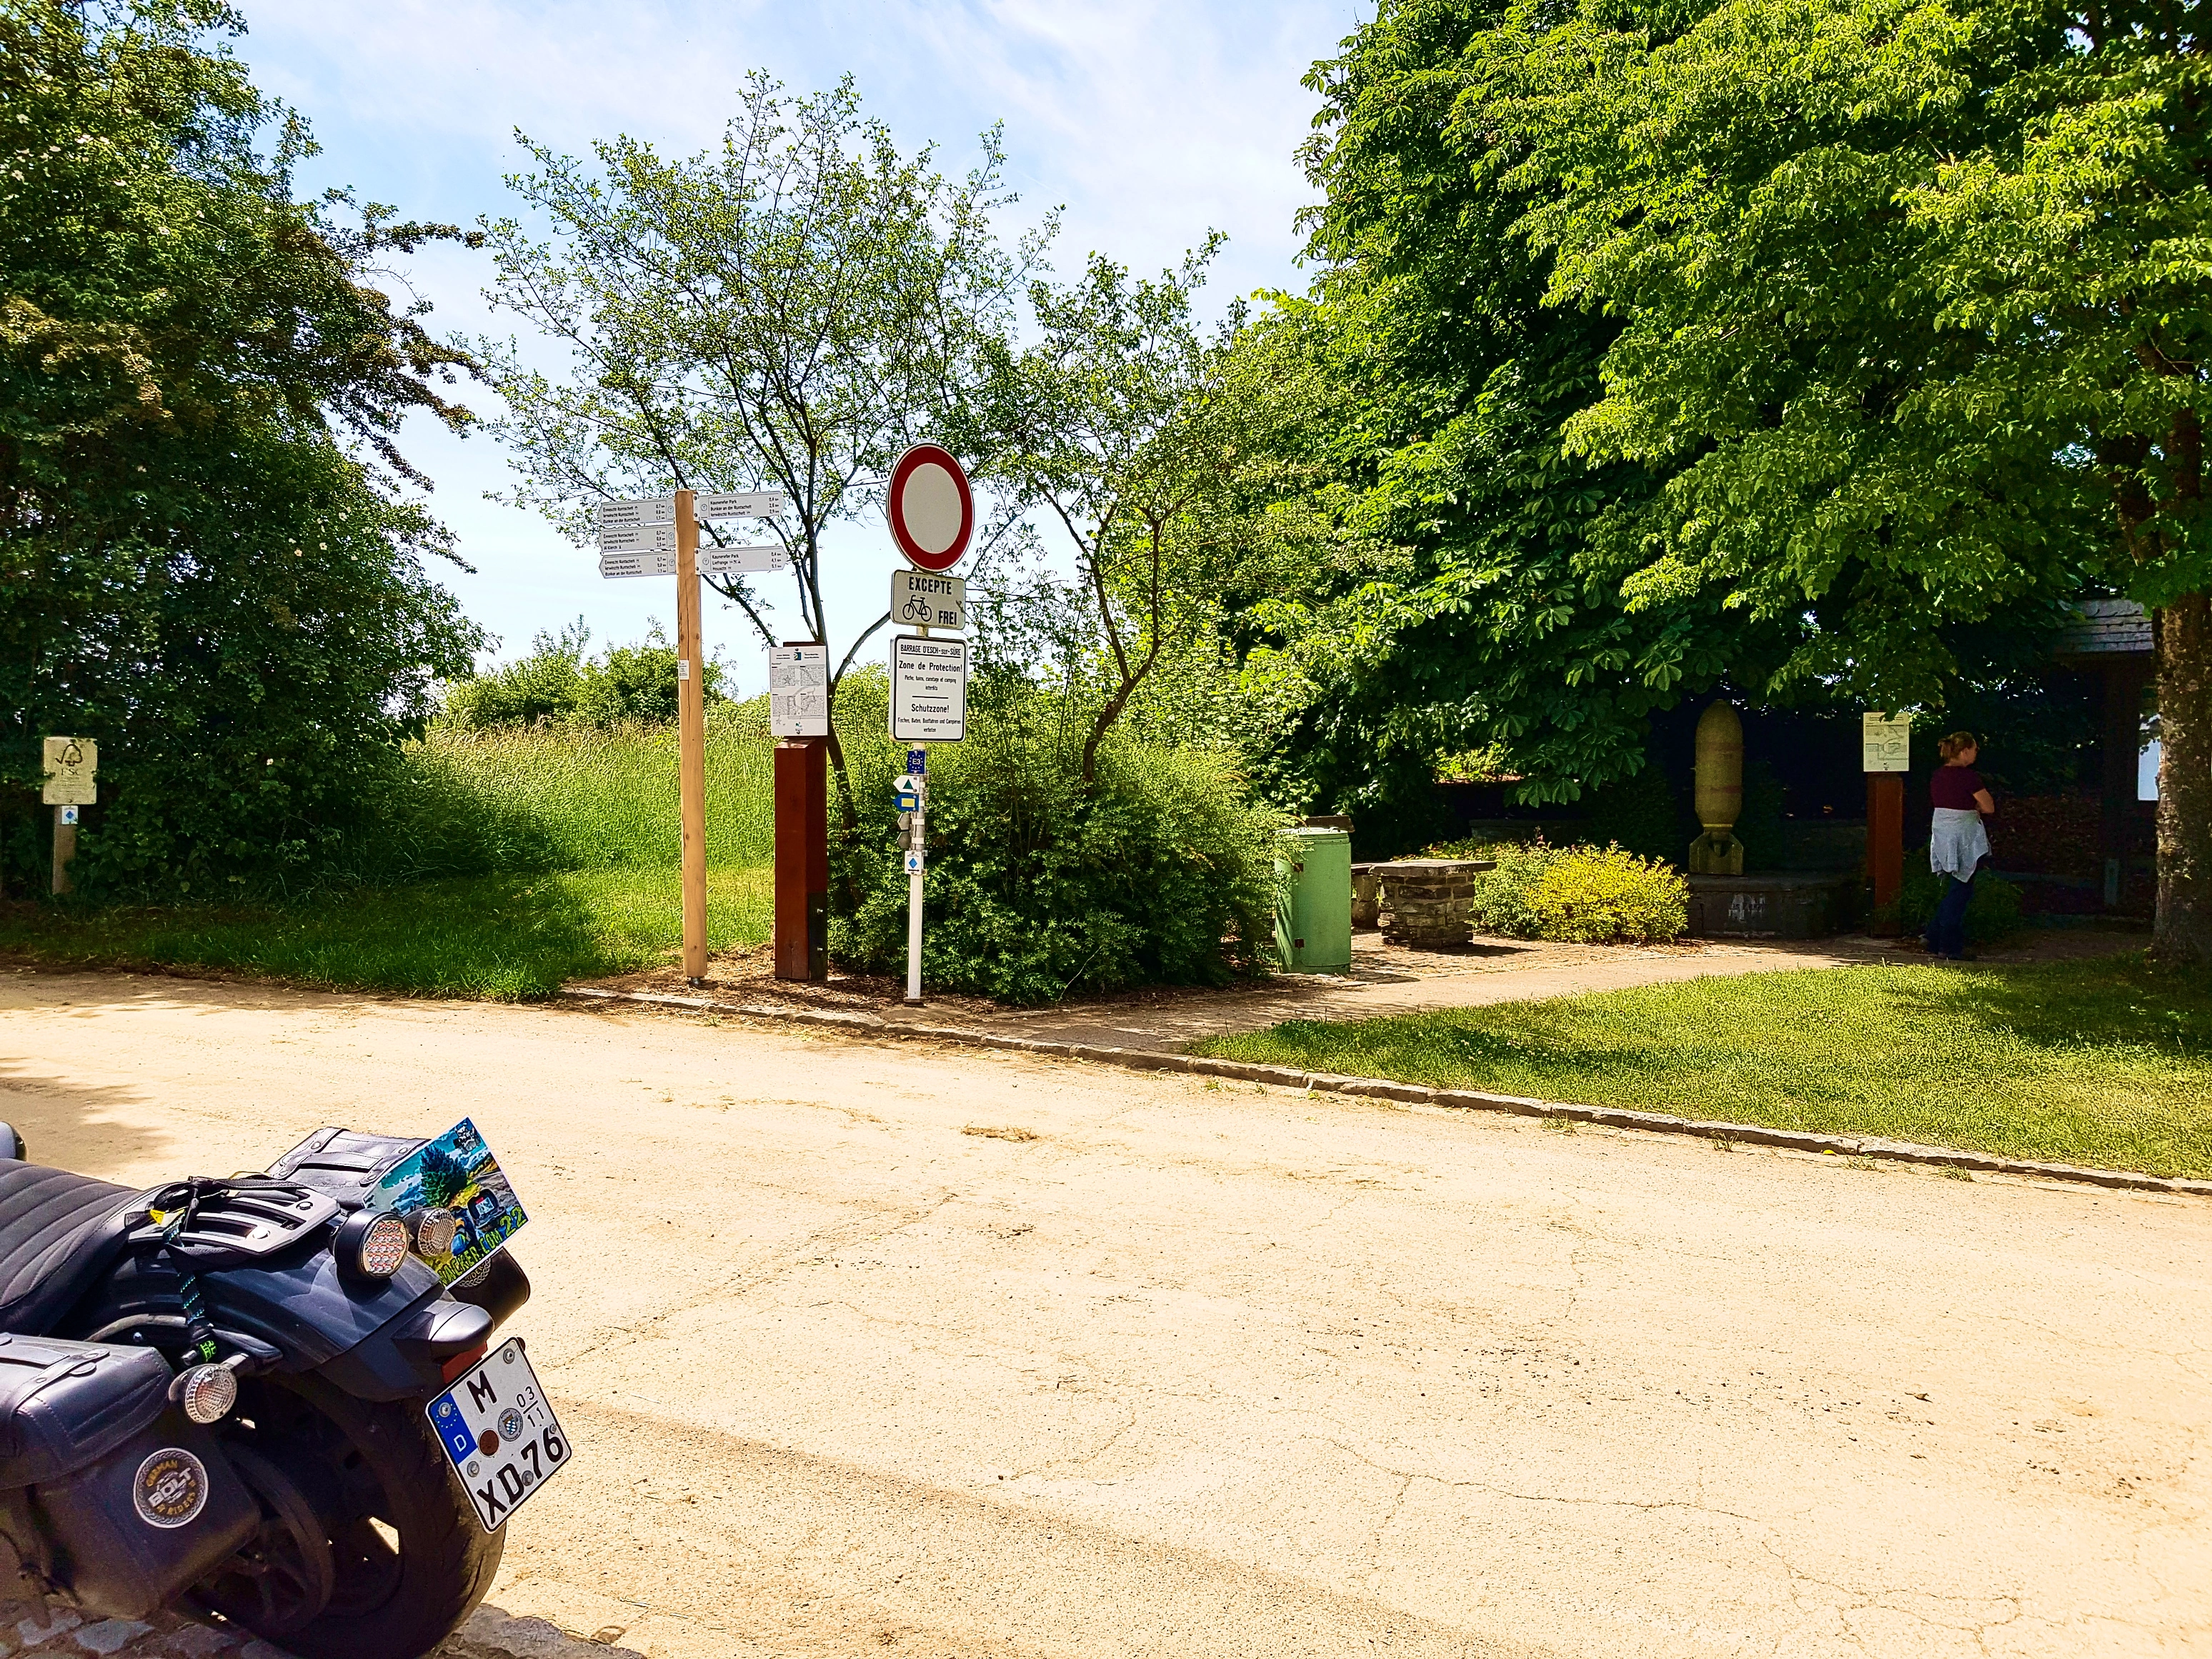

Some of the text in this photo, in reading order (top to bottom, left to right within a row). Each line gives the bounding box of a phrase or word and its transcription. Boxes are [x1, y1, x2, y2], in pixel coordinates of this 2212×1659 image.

[909, 577, 952, 594] EXCEPTE
[939, 610, 957, 624] FREI
[930, 662, 962, 672] Protection!
[912, 704, 949, 712] Schutzzone!
[499, 1205, 527, 1237] 22
[466, 1370, 497, 1414] M
[517, 1386, 534, 1408] 03
[527, 1408, 544, 1427] 11
[454, 1434, 467, 1452] D
[148, 1467, 191, 1508] BOLT
